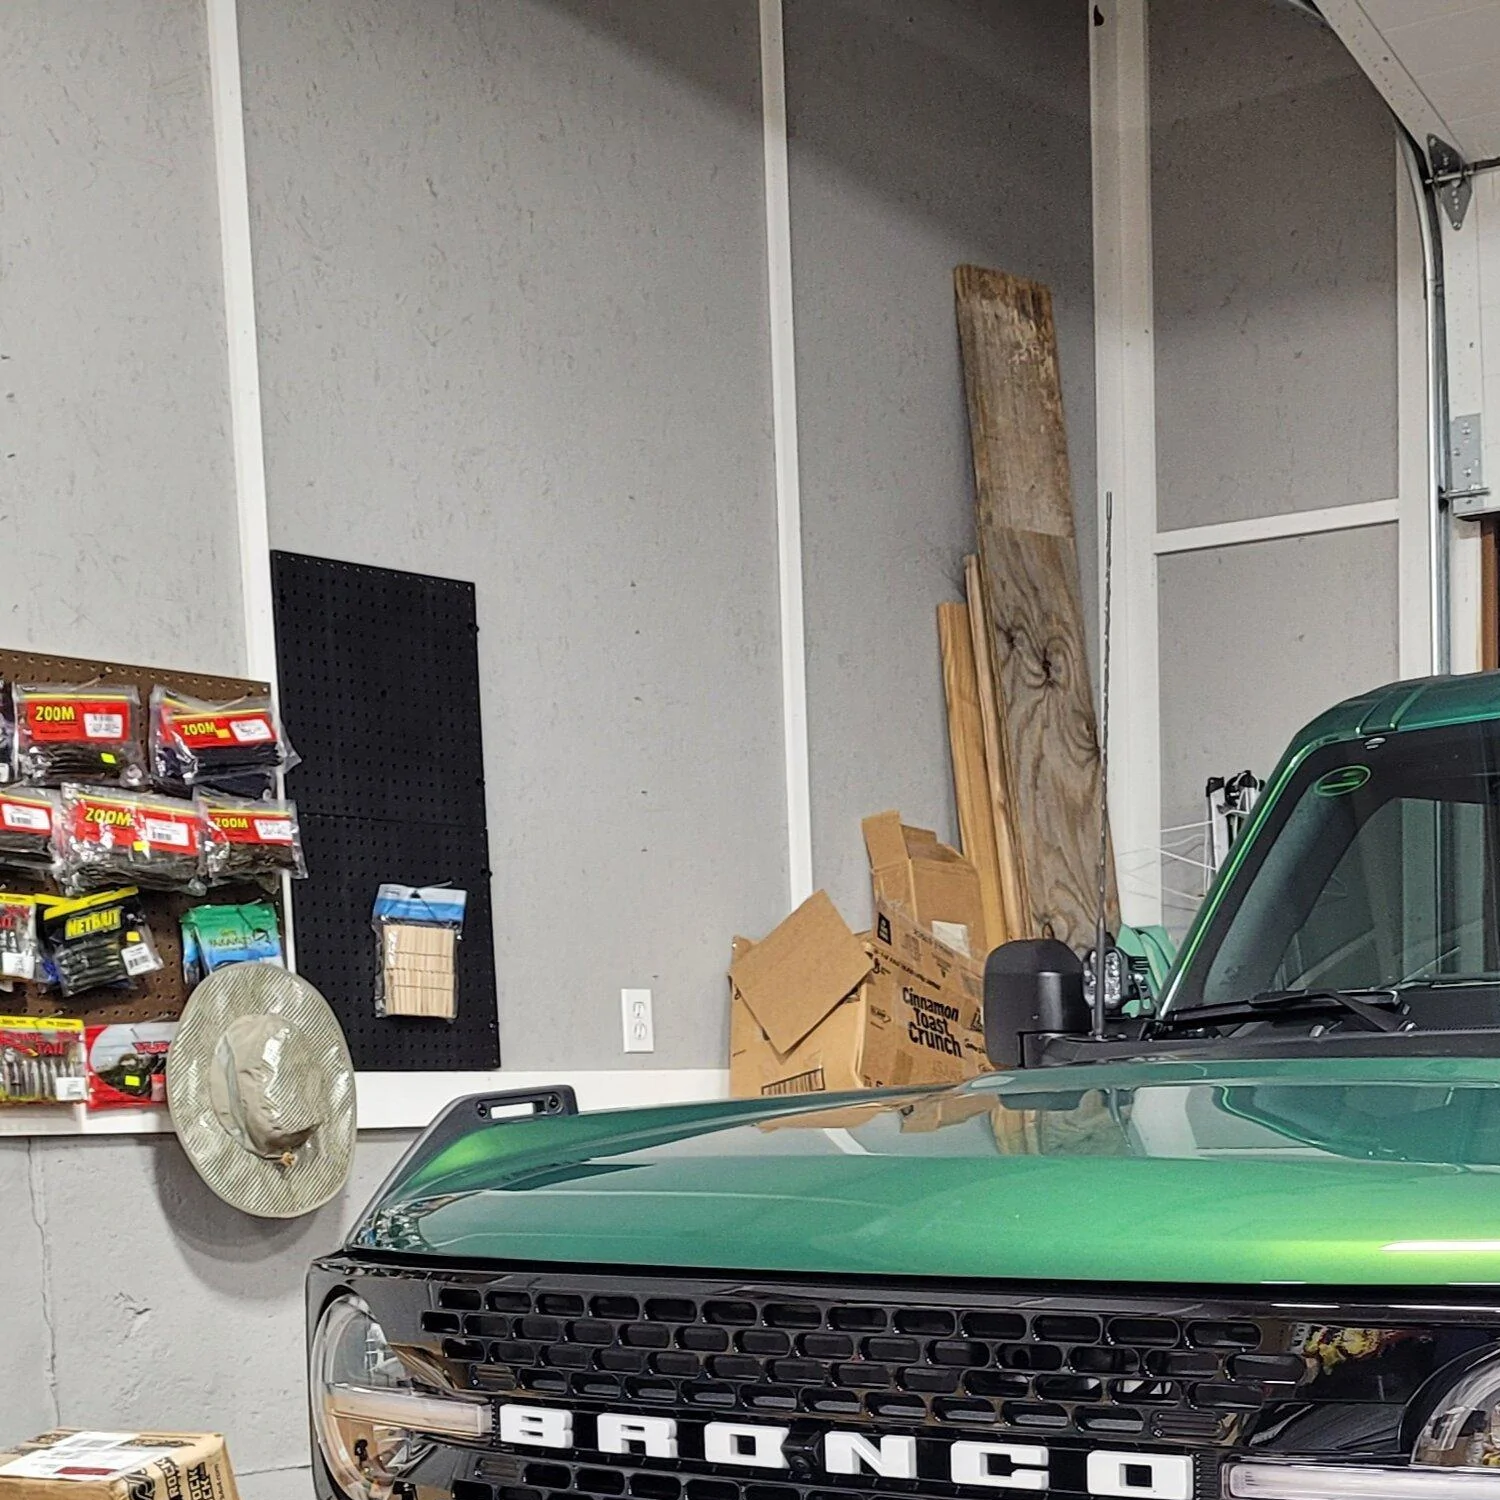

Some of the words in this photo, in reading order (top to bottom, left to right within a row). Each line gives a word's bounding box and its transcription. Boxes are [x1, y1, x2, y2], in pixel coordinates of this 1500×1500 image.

[36, 705, 76, 721] ZOOM
[182, 721, 217, 736] ZOOM
[85, 807, 131, 827] ZOOM
[215, 817, 249, 829] ZOOM
[902, 987, 959, 1022] Cinnamon
[913, 1007, 951, 1037] Toast
[908, 1021, 962, 1058] Crunch
[499, 1403, 1194, 1500] BRONCO
